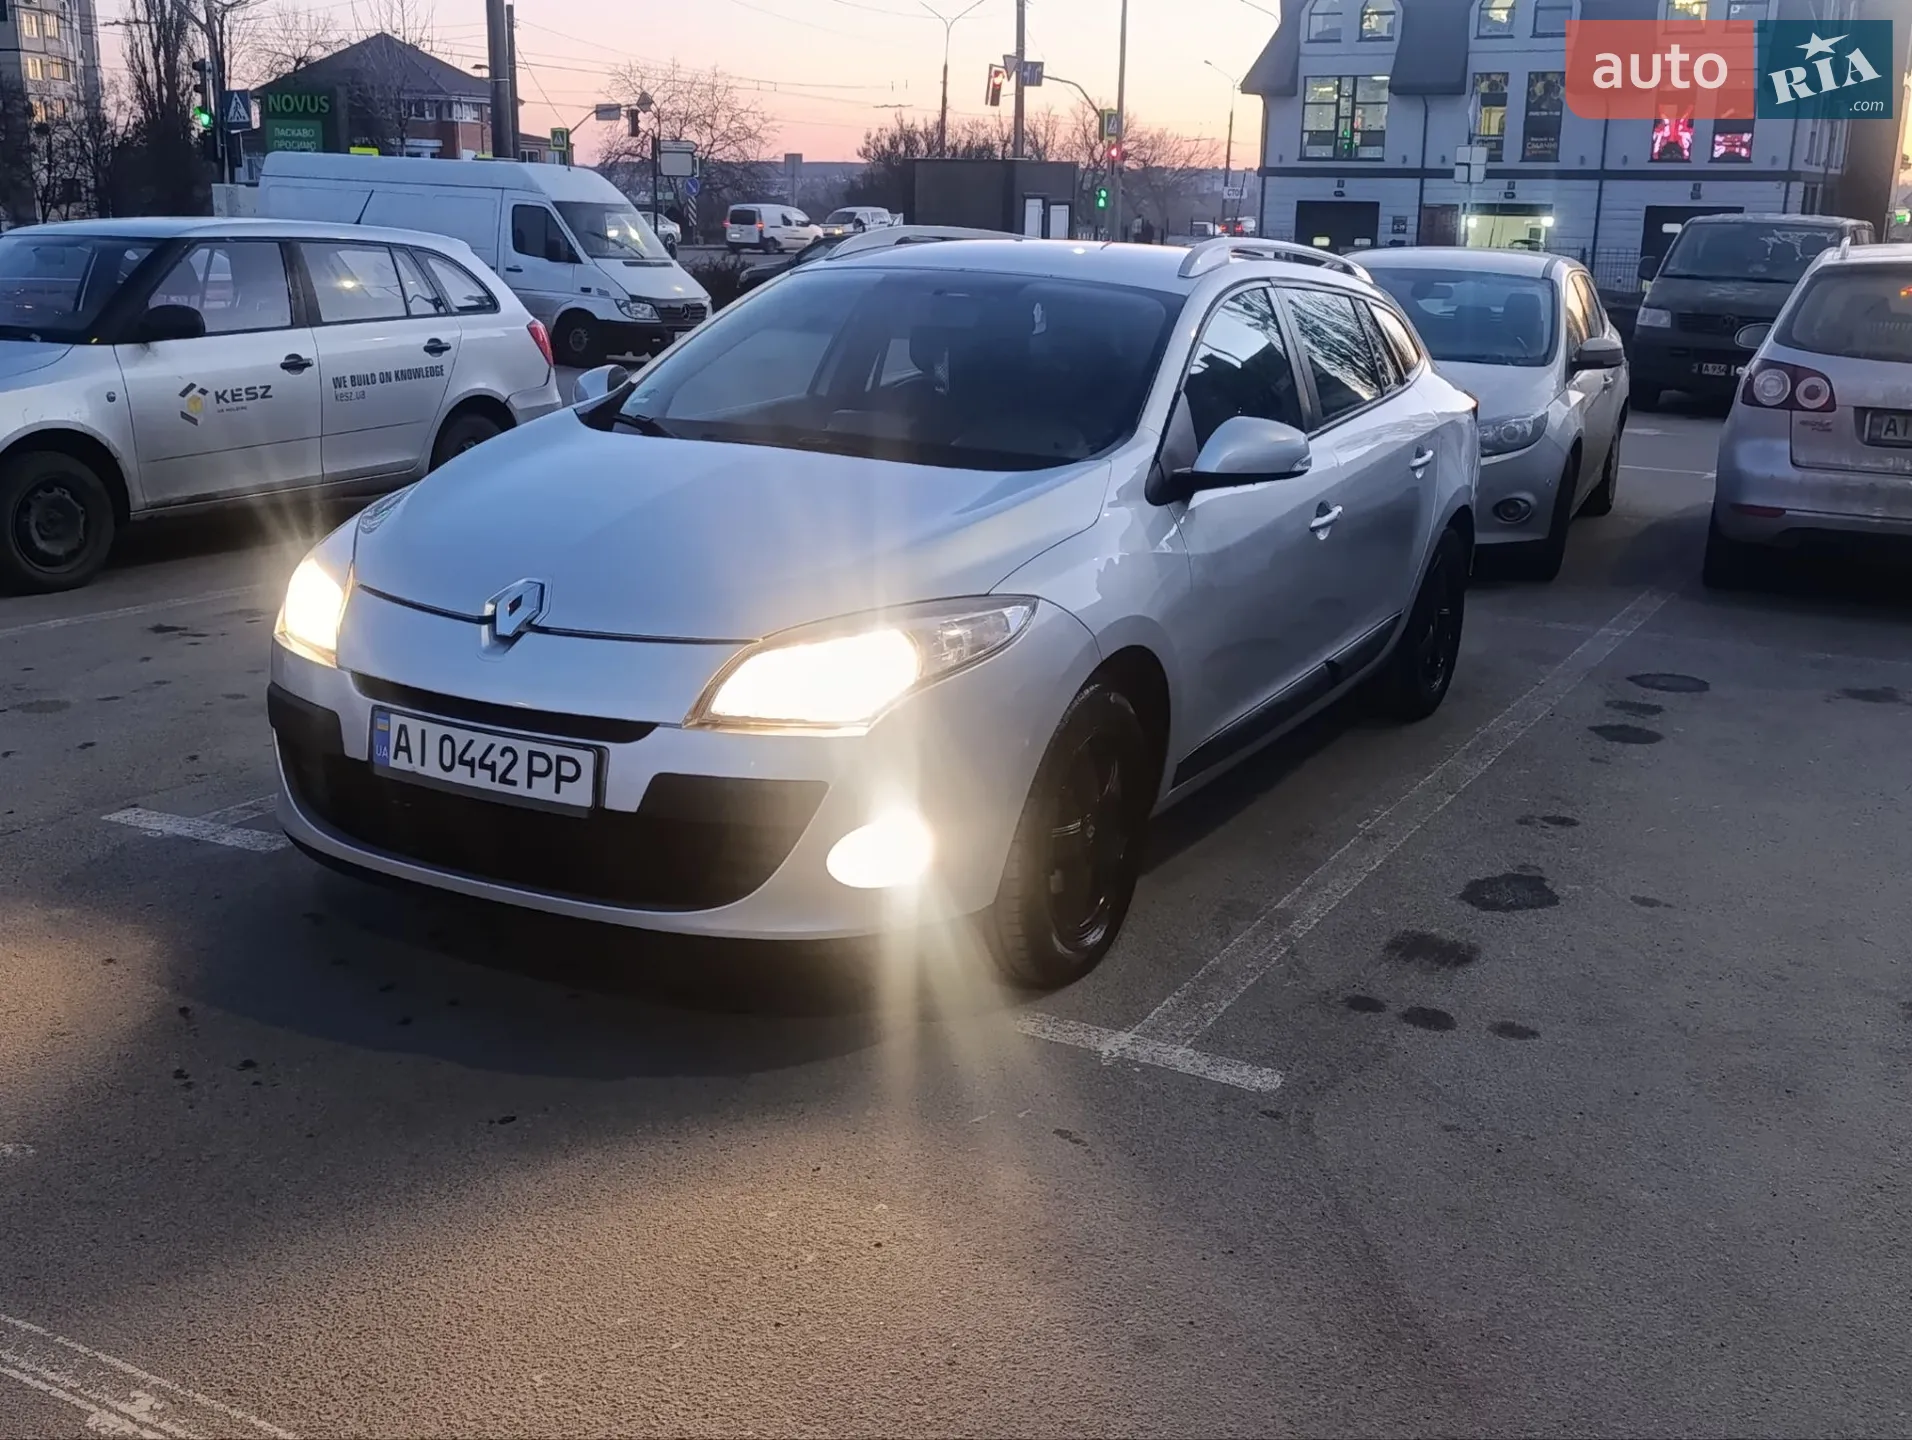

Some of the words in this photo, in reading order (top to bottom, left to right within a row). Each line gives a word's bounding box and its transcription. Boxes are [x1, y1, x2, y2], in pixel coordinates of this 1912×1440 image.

[268, 94, 330, 113] NOVUS
[332, 376, 348, 389] WE
[350, 373, 377, 387] BUILD
[379, 371, 392, 384] ON
[394, 365, 445, 382] KNOWLEDGE
[214, 385, 273, 404] KESZ
[375, 744, 389, 758] UA
[393, 724, 426, 767] AI
[439, 734, 518, 786] 0442
[527, 750, 582, 794] PP
